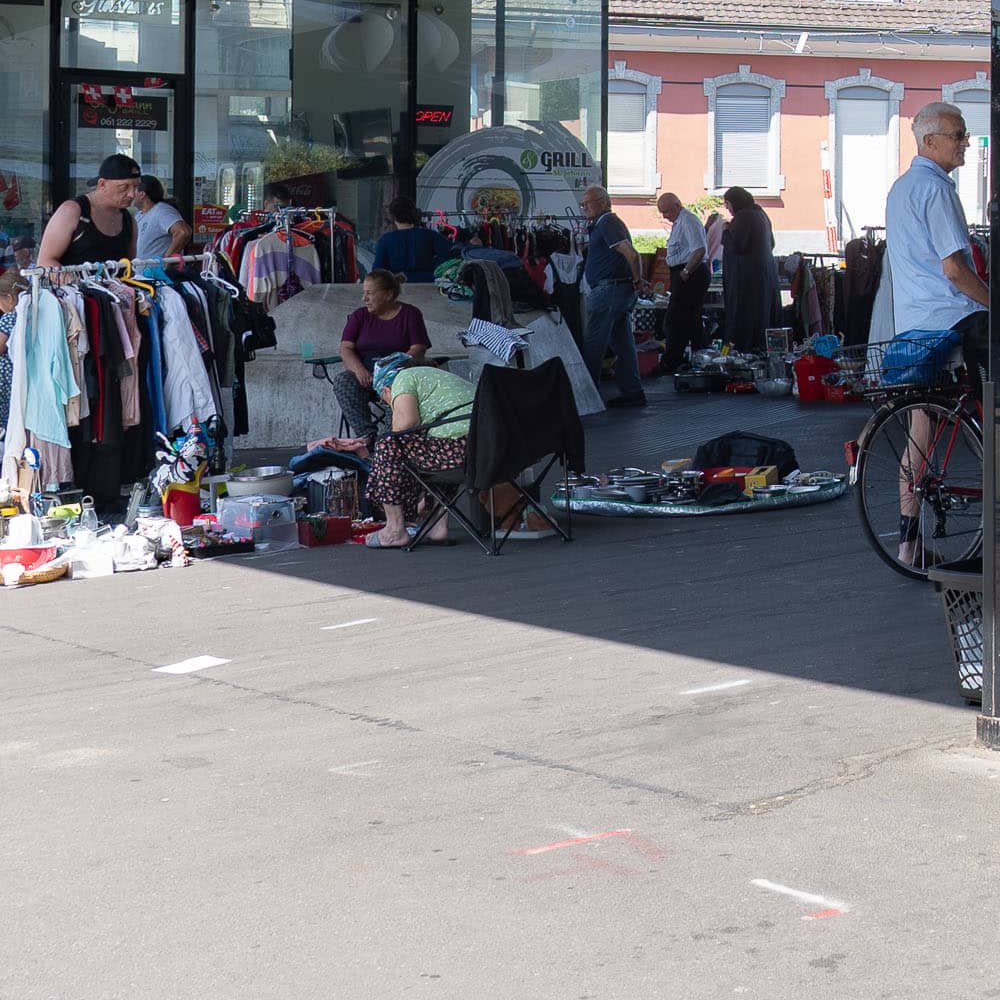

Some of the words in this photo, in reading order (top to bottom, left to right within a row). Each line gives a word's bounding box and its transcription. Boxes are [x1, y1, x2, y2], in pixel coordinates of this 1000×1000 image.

[100, 115, 115, 127] 061
[116, 118, 134, 127] 222
[415, 110, 452, 122] OPEN
[540, 151, 593, 172] GRILL
